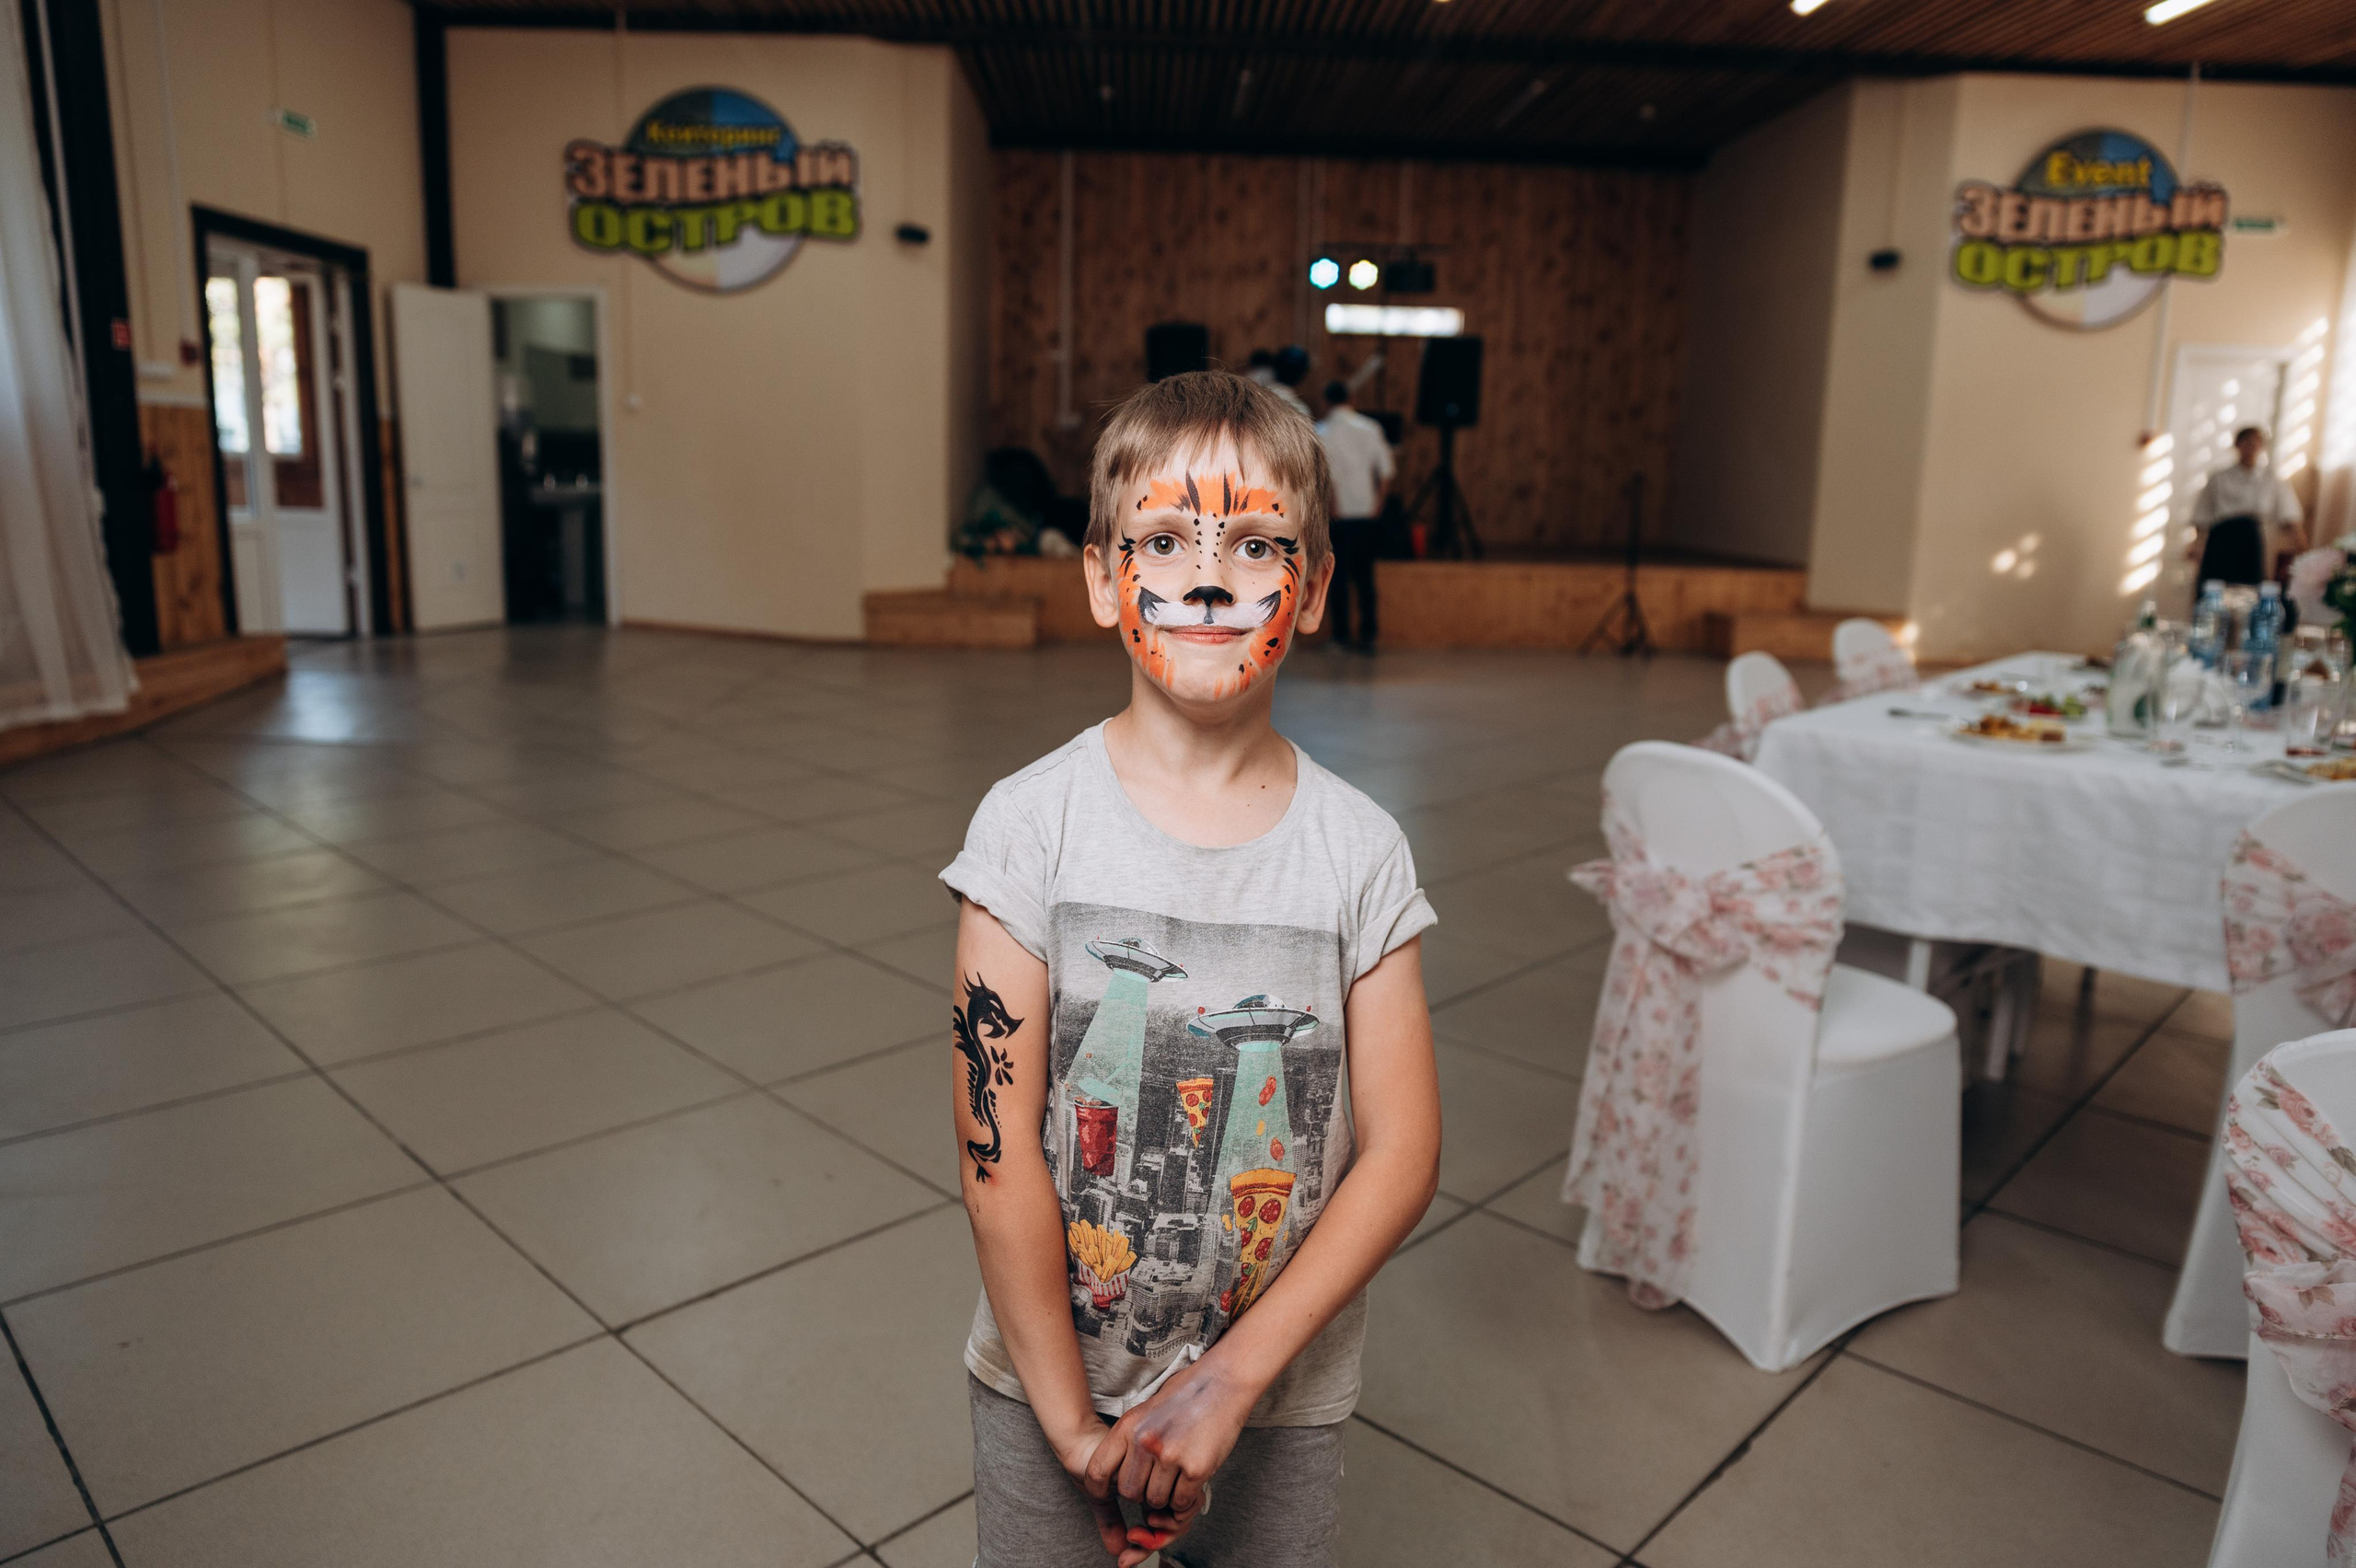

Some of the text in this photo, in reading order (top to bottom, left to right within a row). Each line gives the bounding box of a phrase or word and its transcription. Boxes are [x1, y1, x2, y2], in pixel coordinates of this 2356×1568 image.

[2045, 150, 2153, 189] Event
[573, 190, 858, 254] ОСТРОВ
[1955, 230, 2223, 292] ОСТРОВ
